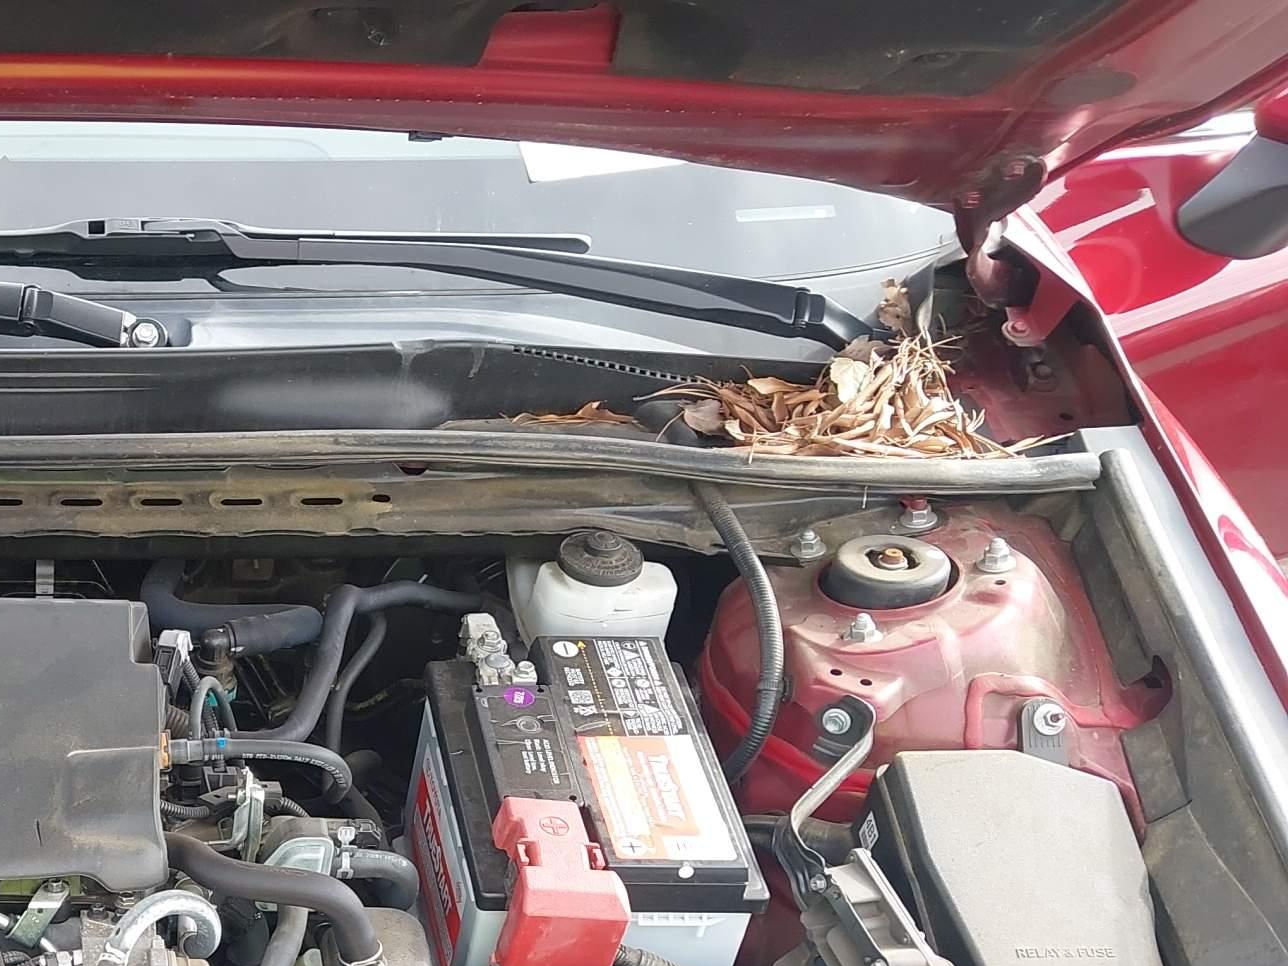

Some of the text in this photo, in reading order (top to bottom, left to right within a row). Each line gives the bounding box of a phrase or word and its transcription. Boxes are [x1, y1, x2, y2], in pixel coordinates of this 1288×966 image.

[1016, 947, 1116, 959] RELAY & FUSE
